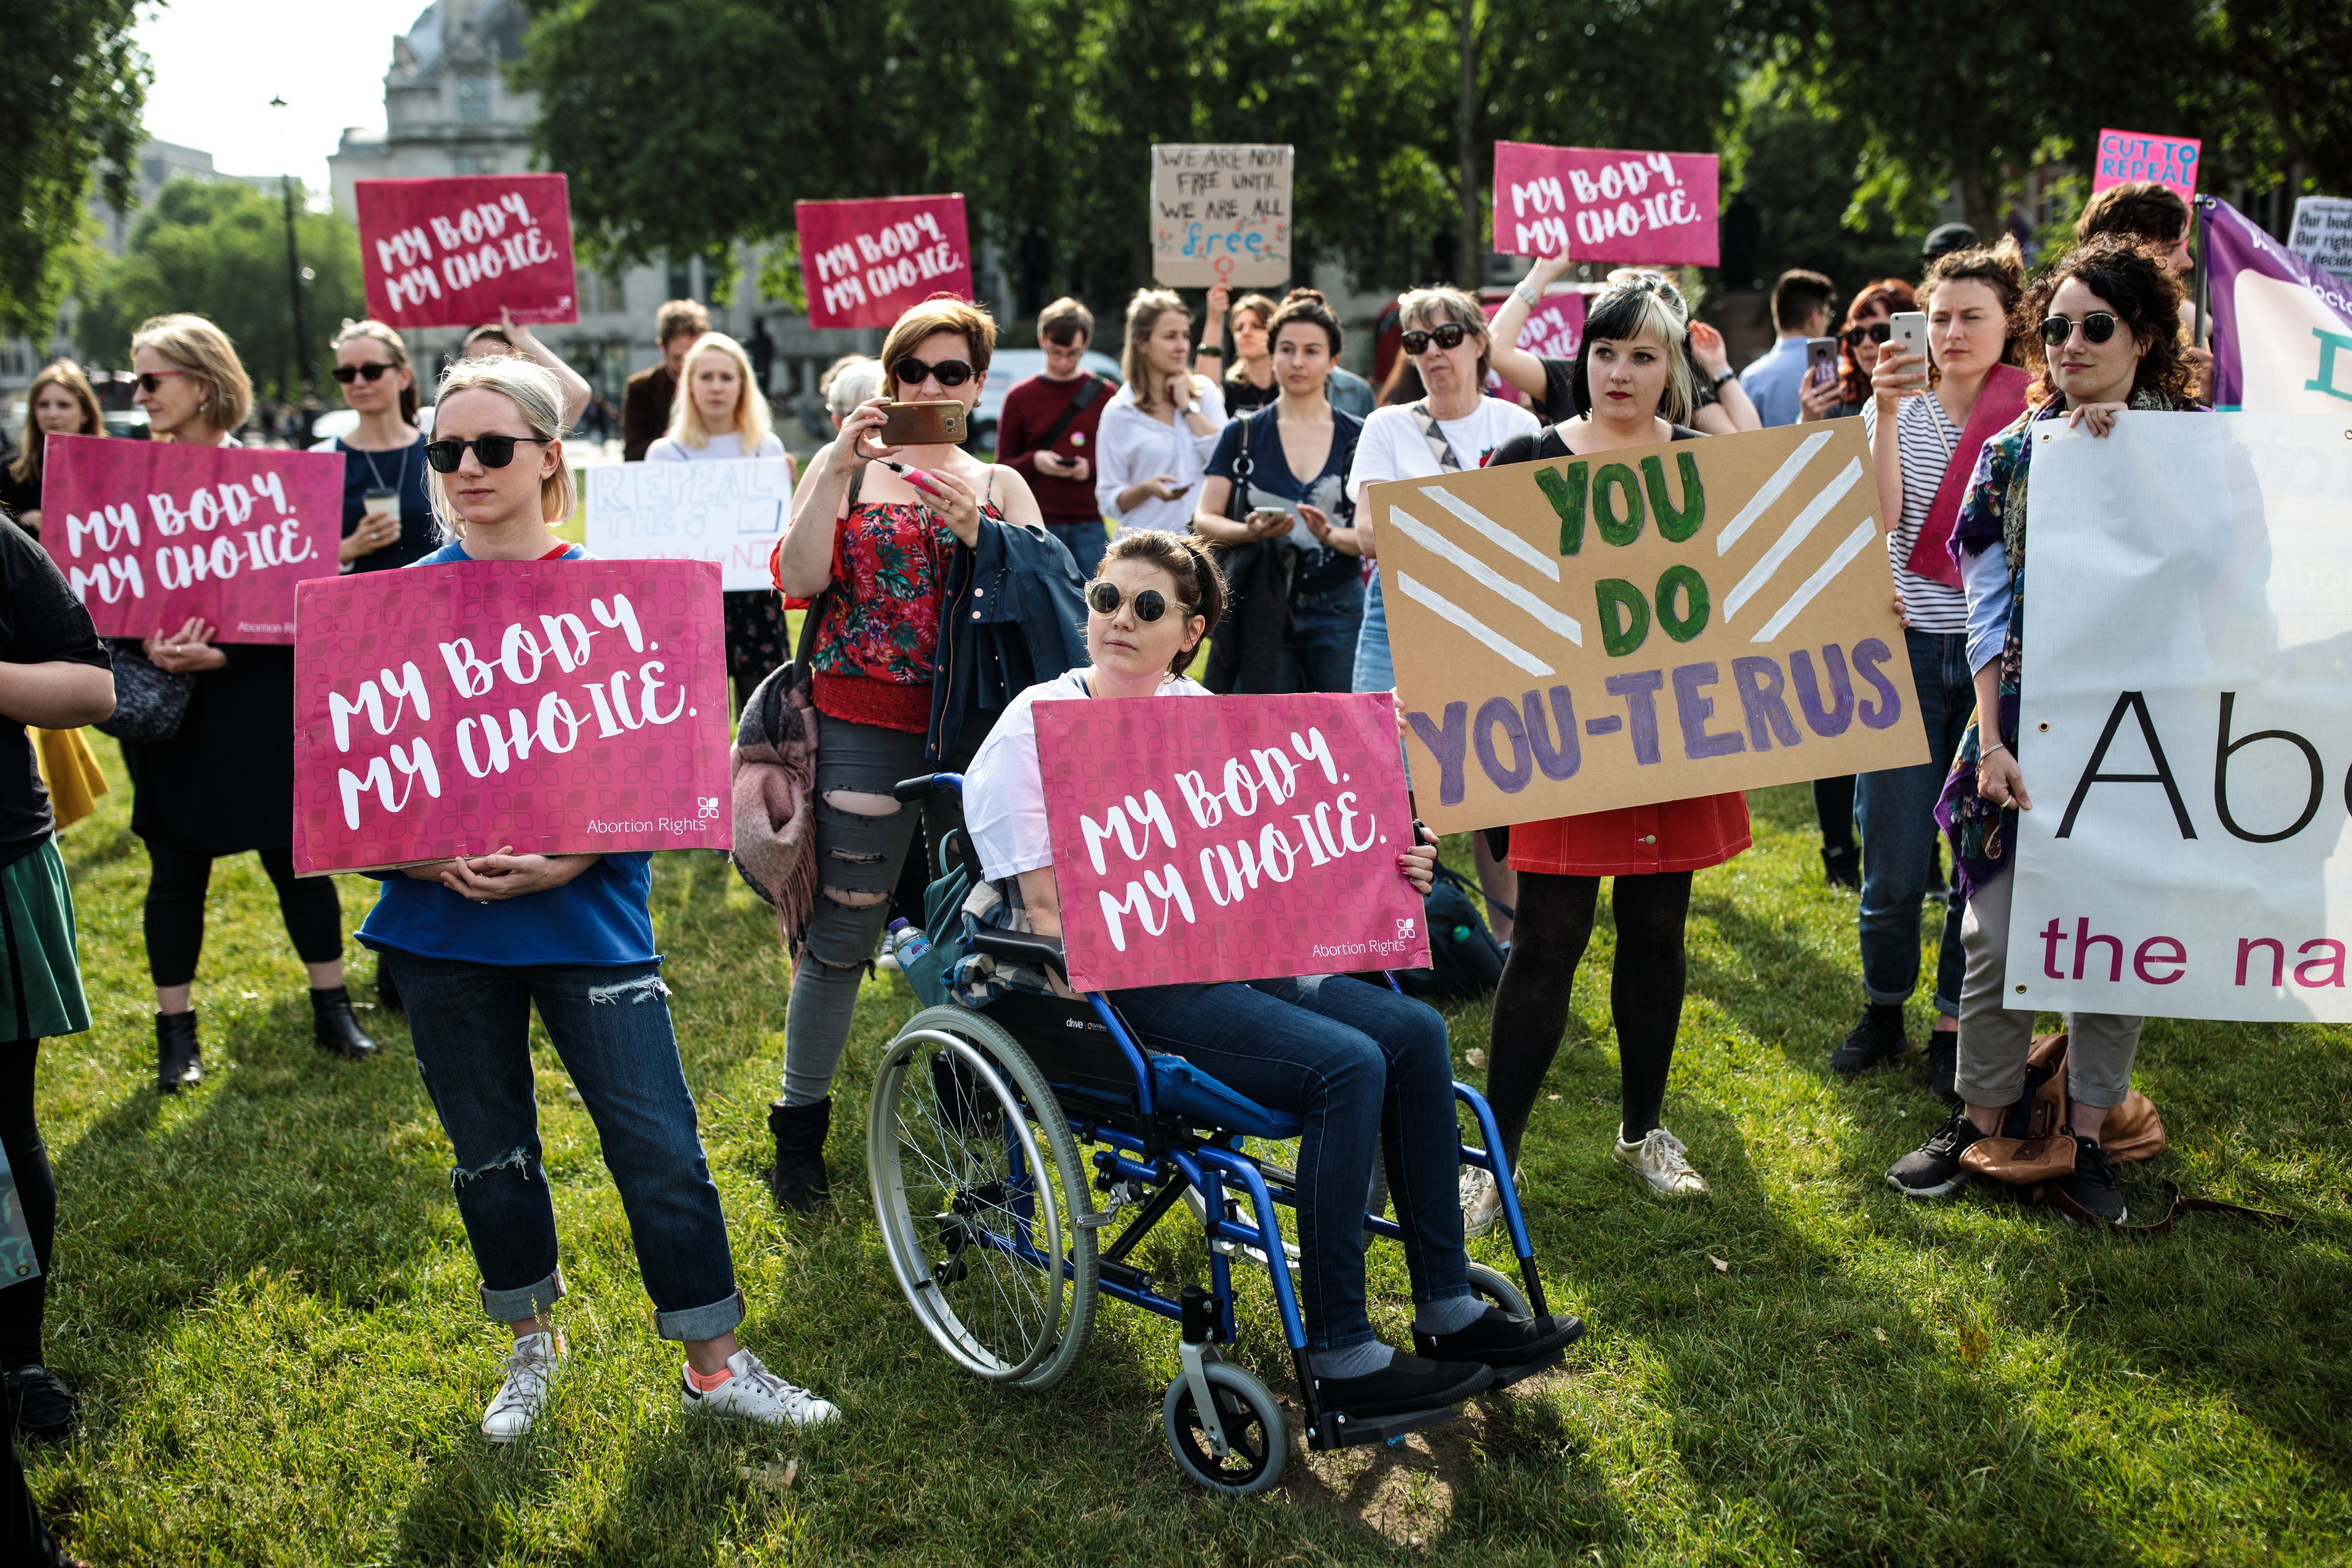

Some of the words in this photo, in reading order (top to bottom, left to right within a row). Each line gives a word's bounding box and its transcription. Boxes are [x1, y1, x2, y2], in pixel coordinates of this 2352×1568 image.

[1159, 149, 1197, 167] WE
[1202, 148, 1242, 170] ARE
[1248, 148, 1286, 167] NOT
[2102, 135, 2154, 159] CUT
[2162, 143, 2197, 165] TO
[2102, 157, 2192, 186] REPEAL
[1159, 201, 1195, 218] WE
[1205, 199, 1239, 220] ARE
[1252, 198, 1285, 217] ALL
[1177, 171, 1221, 196] FREE
[1232, 172, 1280, 192] UNTIL
[1511, 176, 1566, 218] MY
[1569, 152, 1684, 204] BODY.
[375, 226, 433, 274] MY
[430, 191, 538, 251] BODY.
[814, 242, 859, 283] MY
[855, 211, 947, 264] BODY.
[1182, 222, 1263, 256] free
[1516, 216, 1569, 254] MY
[1576, 188, 1702, 245] CHOICE.
[2297, 231, 2318, 246] Our
[2324, 235, 2352, 253] righ
[2300, 211, 2321, 227] Our
[2327, 214, 2352, 229] bod
[385, 264, 442, 313] MY
[442, 227, 559, 291] CHOICE.
[822, 275, 867, 316] MY
[866, 241, 965, 297] CHOICE.
[66, 502, 141, 558] MY
[147, 471, 297, 536] BODY.
[592, 460, 774, 512] REPEAL
[1534, 451, 1705, 557] YOU
[593, 505, 676, 539] THE
[70, 554, 145, 604] MY
[156, 518, 319, 590] CHOICE.
[237, 621, 283, 633] Abortion
[1595, 564, 1710, 657] DO
[329, 661, 431, 752] MY
[438, 593, 659, 699] BODY.
[338, 737, 441, 831] MY
[456, 661, 697, 778] CHOICE.
[1405, 638, 1901, 806] YOU-TERUS
[2054, 690, 2352, 844] Ab
[586, 817, 653, 834] Abortion
[658, 817, 707, 835] Rights
[1080, 789, 1177, 875] MY
[1174, 727, 1350, 829] BODY.
[1099, 863, 1195, 952] MY
[1200, 791, 1387, 906] CHOICE.
[1312, 941, 1366, 958] Abortion
[1369, 939, 1406, 957] Rights
[2039, 916, 2187, 985] the
[2234, 937, 2346, 988] na
[1066, 1018, 1083, 1029] drive
